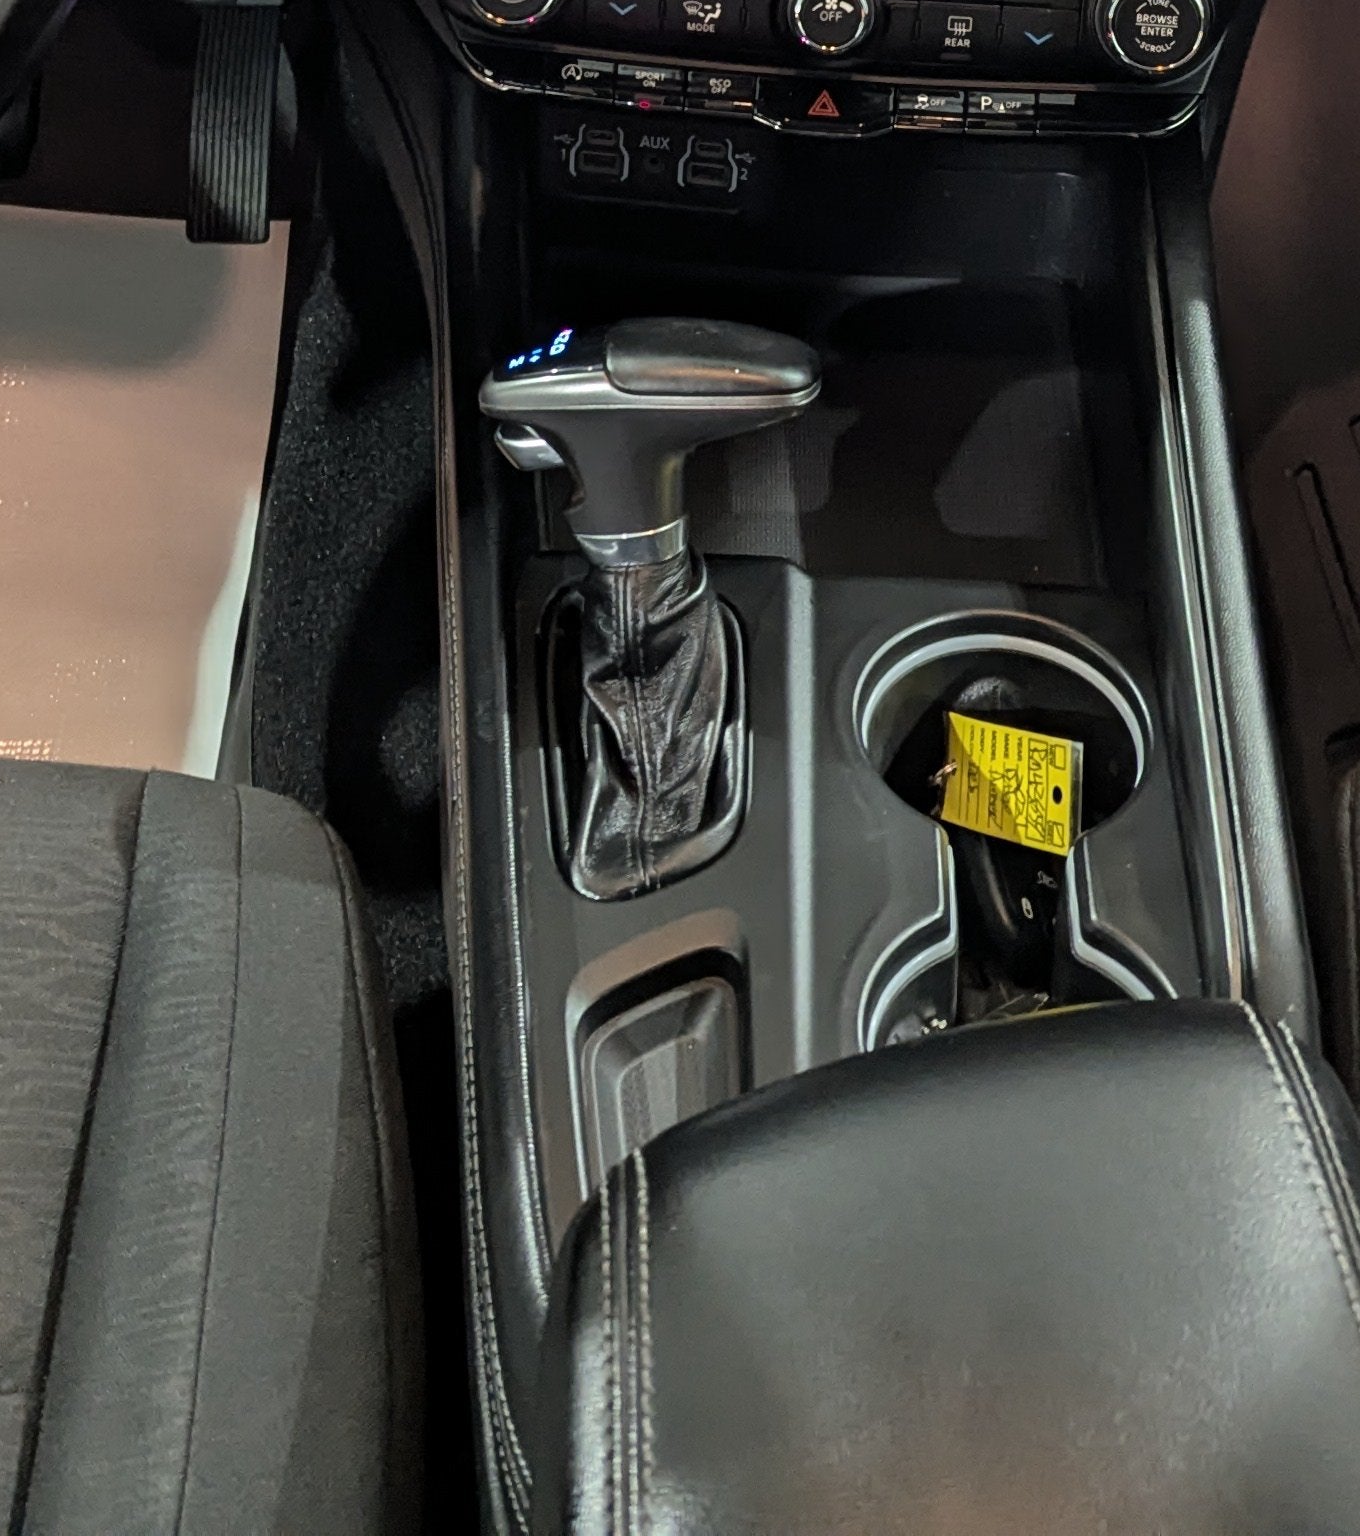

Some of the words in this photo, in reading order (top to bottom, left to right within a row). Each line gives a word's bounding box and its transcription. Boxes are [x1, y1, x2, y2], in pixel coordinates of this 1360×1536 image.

[819, 10, 843, 23] OFF
[1136, 14, 1179, 25] BROWSE
[686, 22, 716, 33] MODE
[1140, 27, 1174, 38] ENTER
[944, 37, 971, 48] REAR
[1139, 41, 1172, 54] SCROLL
[583, 71, 600, 79] OFF
[634, 71, 666, 82] SPORT
[643, 79, 656, 88] ON
[709, 78, 732, 89] eco
[711, 86, 727, 94] OFF
[930, 98, 946, 107] OFF
[1006, 101, 1022, 110] OFF
[640, 136, 670, 151] AUX
[740, 168, 748, 181] 2
[990, 730, 998, 761] MODEL
[1016, 735, 1024, 762] YEAR
